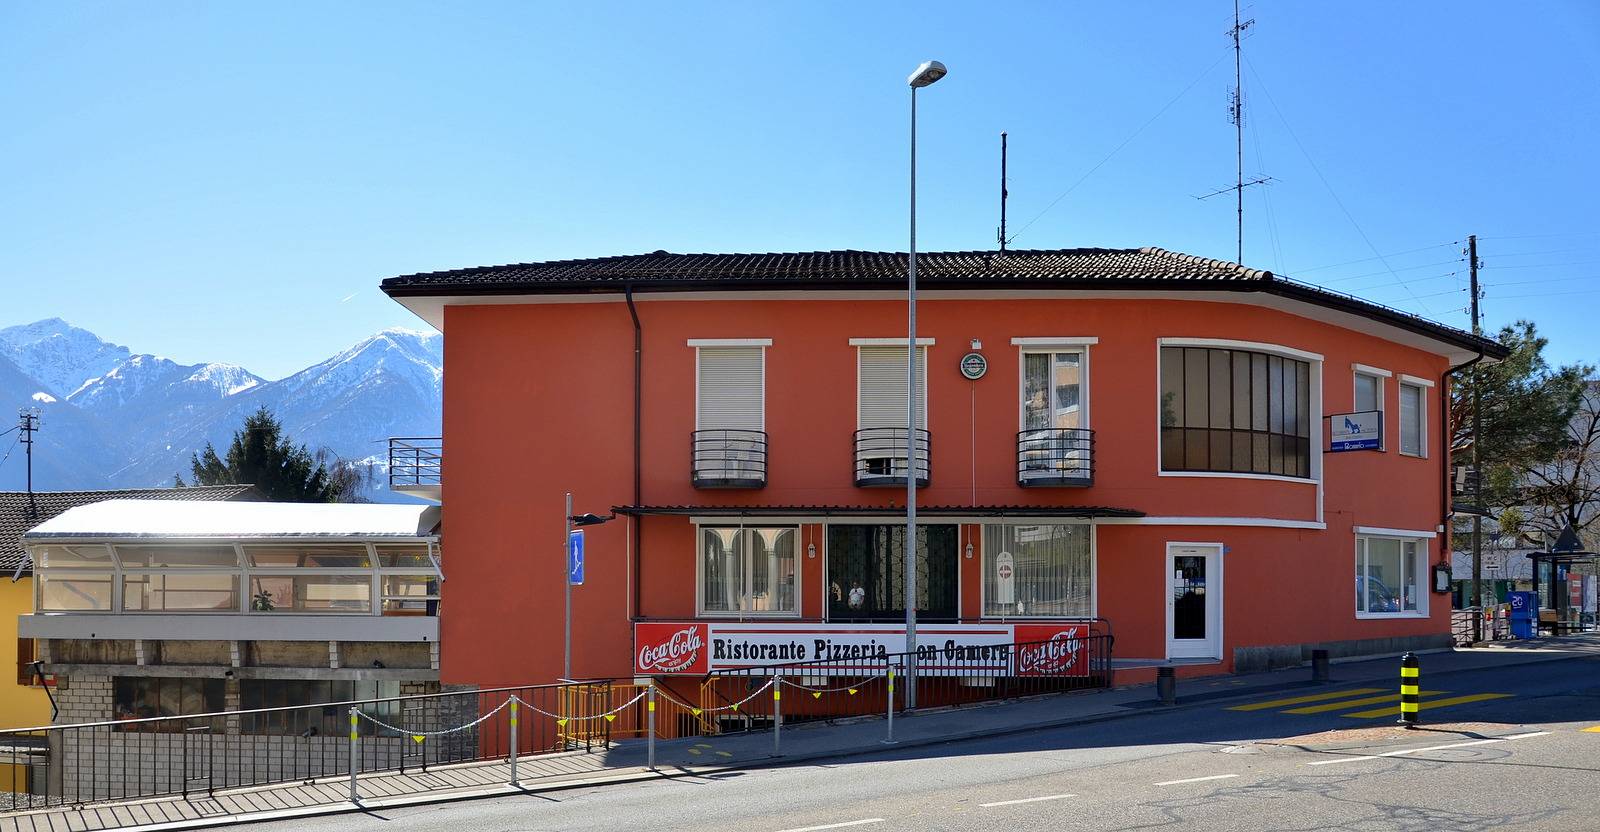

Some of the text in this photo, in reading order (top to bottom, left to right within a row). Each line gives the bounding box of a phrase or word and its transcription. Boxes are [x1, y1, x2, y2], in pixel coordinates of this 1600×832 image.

[639, 625, 702, 670] Coca-Cola
[713, 639, 1009, 660] Ristorante Pizzeria on Camere
